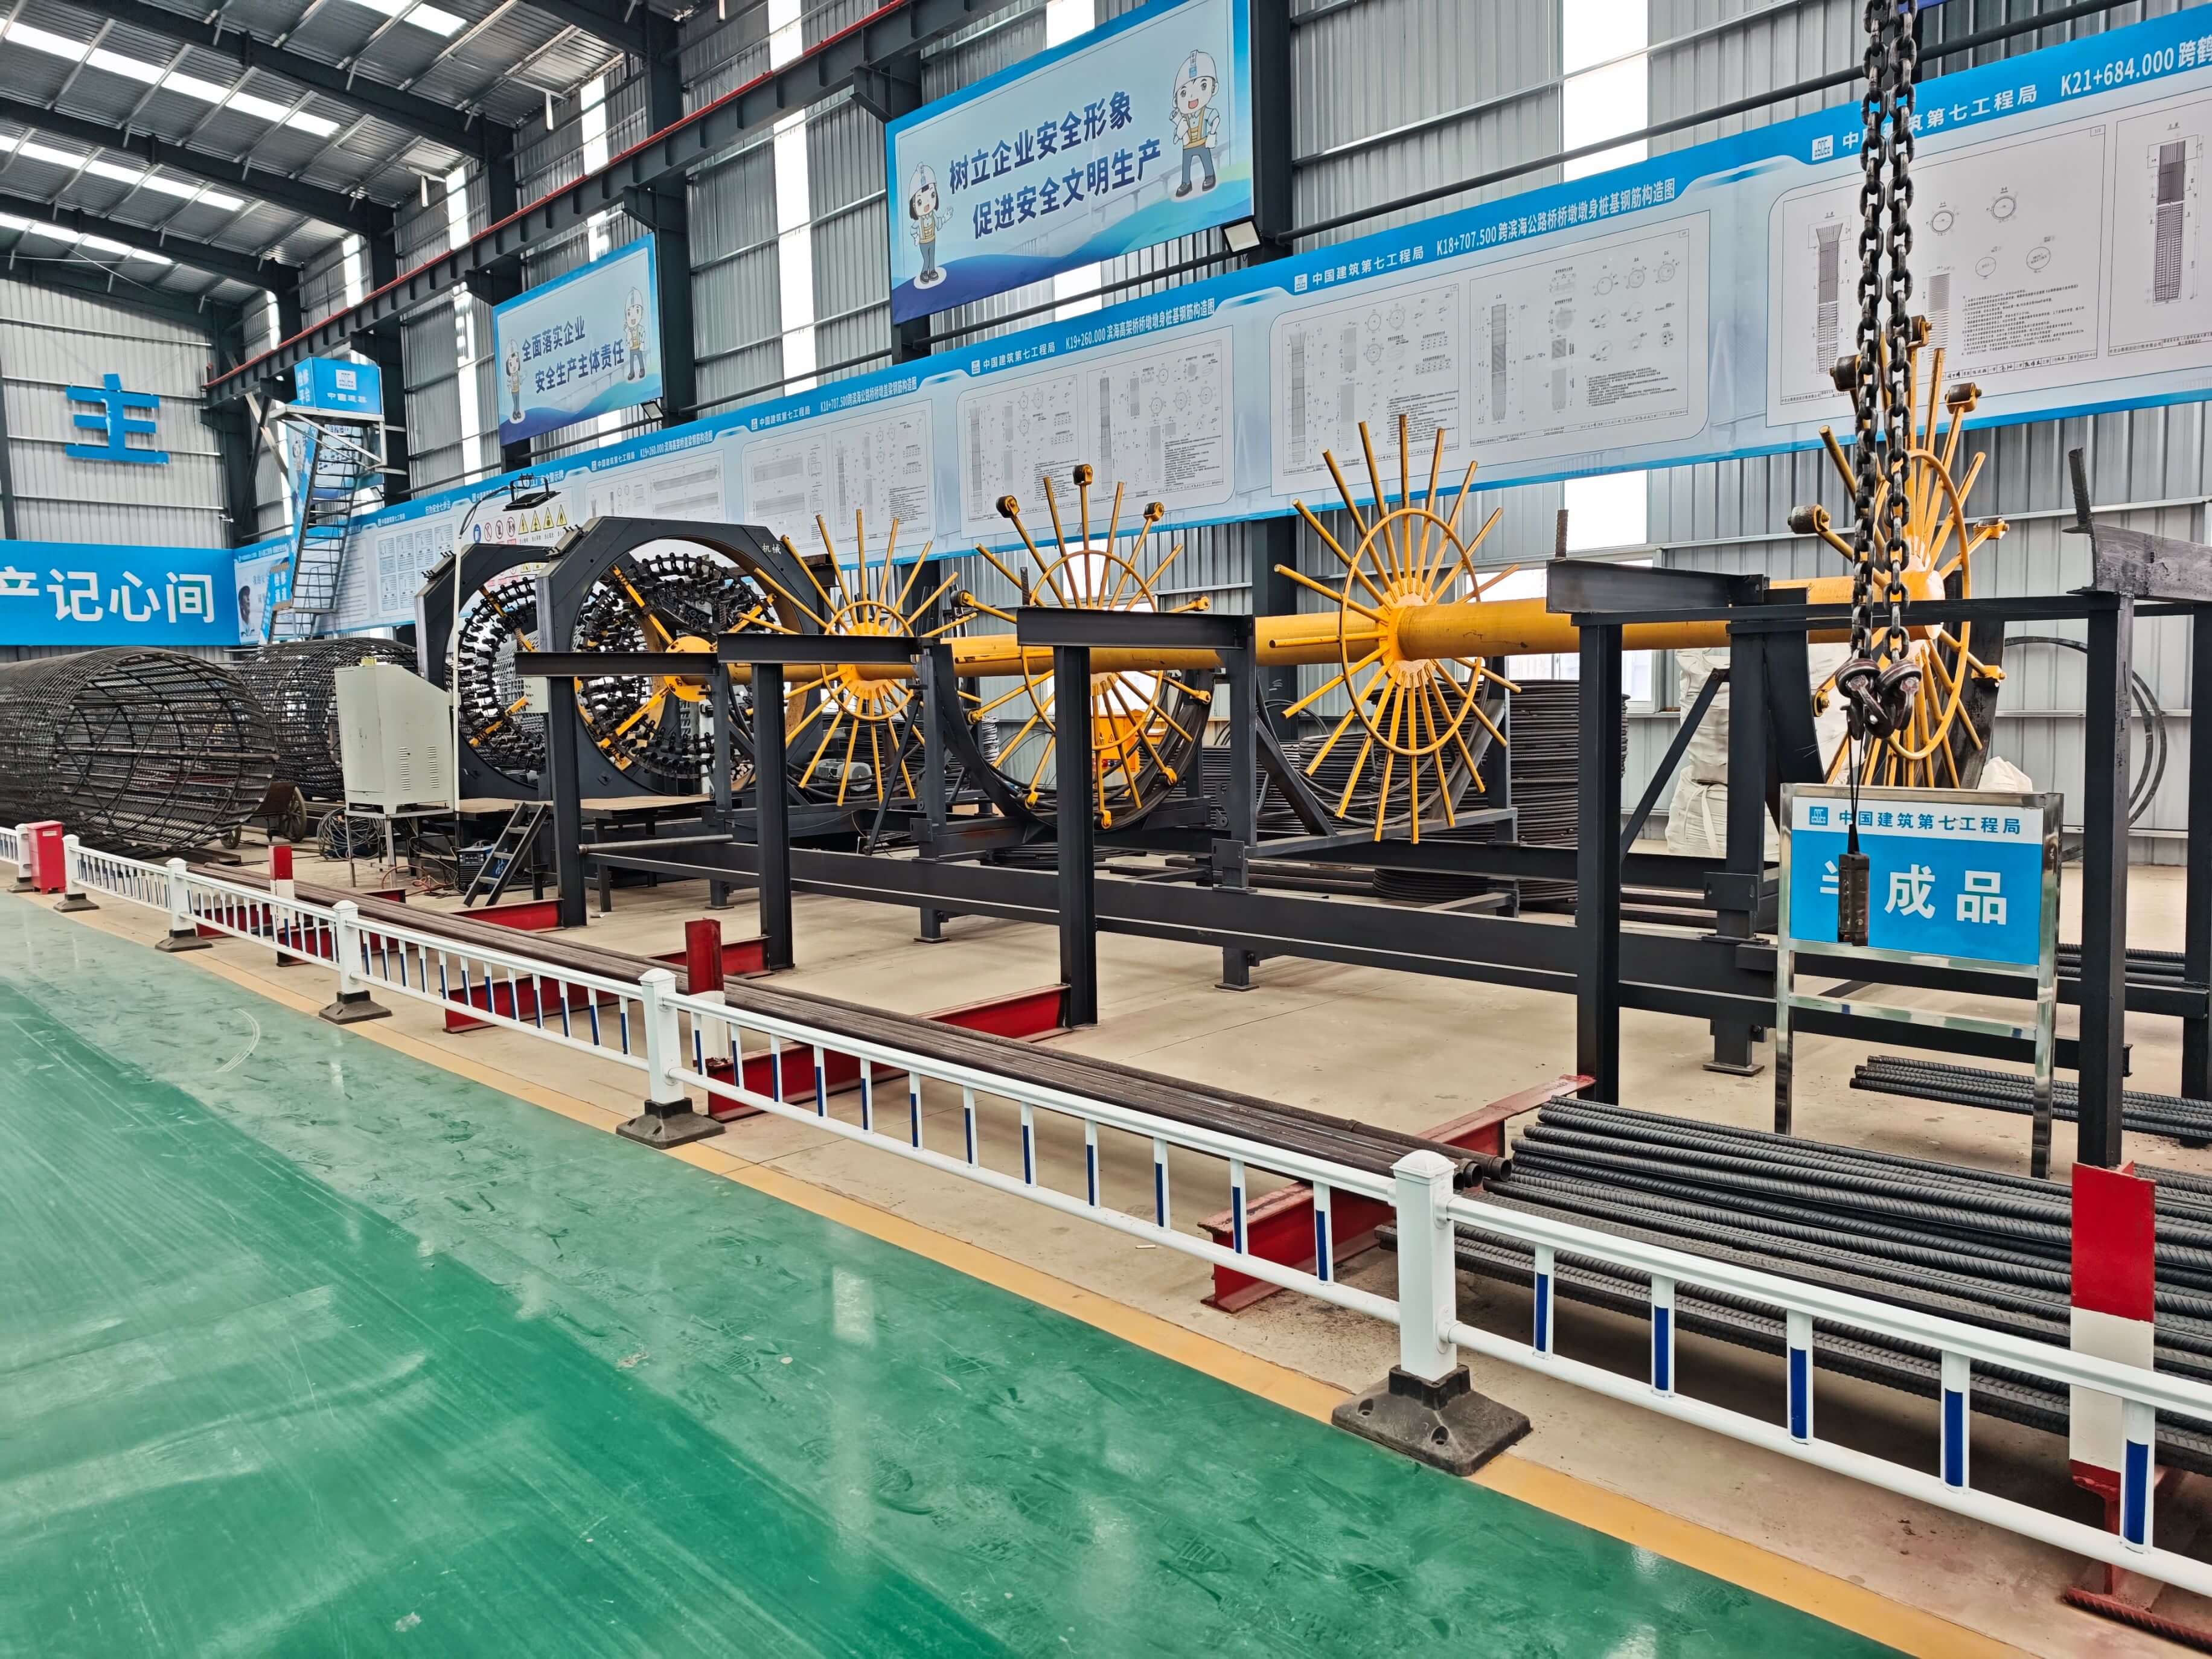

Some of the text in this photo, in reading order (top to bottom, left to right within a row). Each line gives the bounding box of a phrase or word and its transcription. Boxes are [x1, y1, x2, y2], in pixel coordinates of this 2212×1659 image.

[1843, 84, 2038, 150] 中筑第七工程局
[2061, 48, 2174, 97] K21+684.000
[950, 91, 1133, 194] 树立企业安全形象
[973, 138, 1161, 239] 促进安全文明生产
[1312, 177, 1675, 286] 中国建筑第七工程局 K18+707.500 跨滨海公路桥桥墩墩身桩基钢筋构造图
[522, 315, 585, 362] 全面落实企业
[983, 298, 1215, 369] 中国建筑第七工程局 K19+260.000 滨海高架桥桥墩墩身桩基钢筋构造图
[535, 339, 624, 394] 安全生产主体责任
[759, 406, 810, 426] 中国建筑第七工程局
[762, 543, 782, 555] 机械
[0, 566, 214, 623] 产记心间
[1839, 809, 2021, 835] 中国建筑第七工程局
